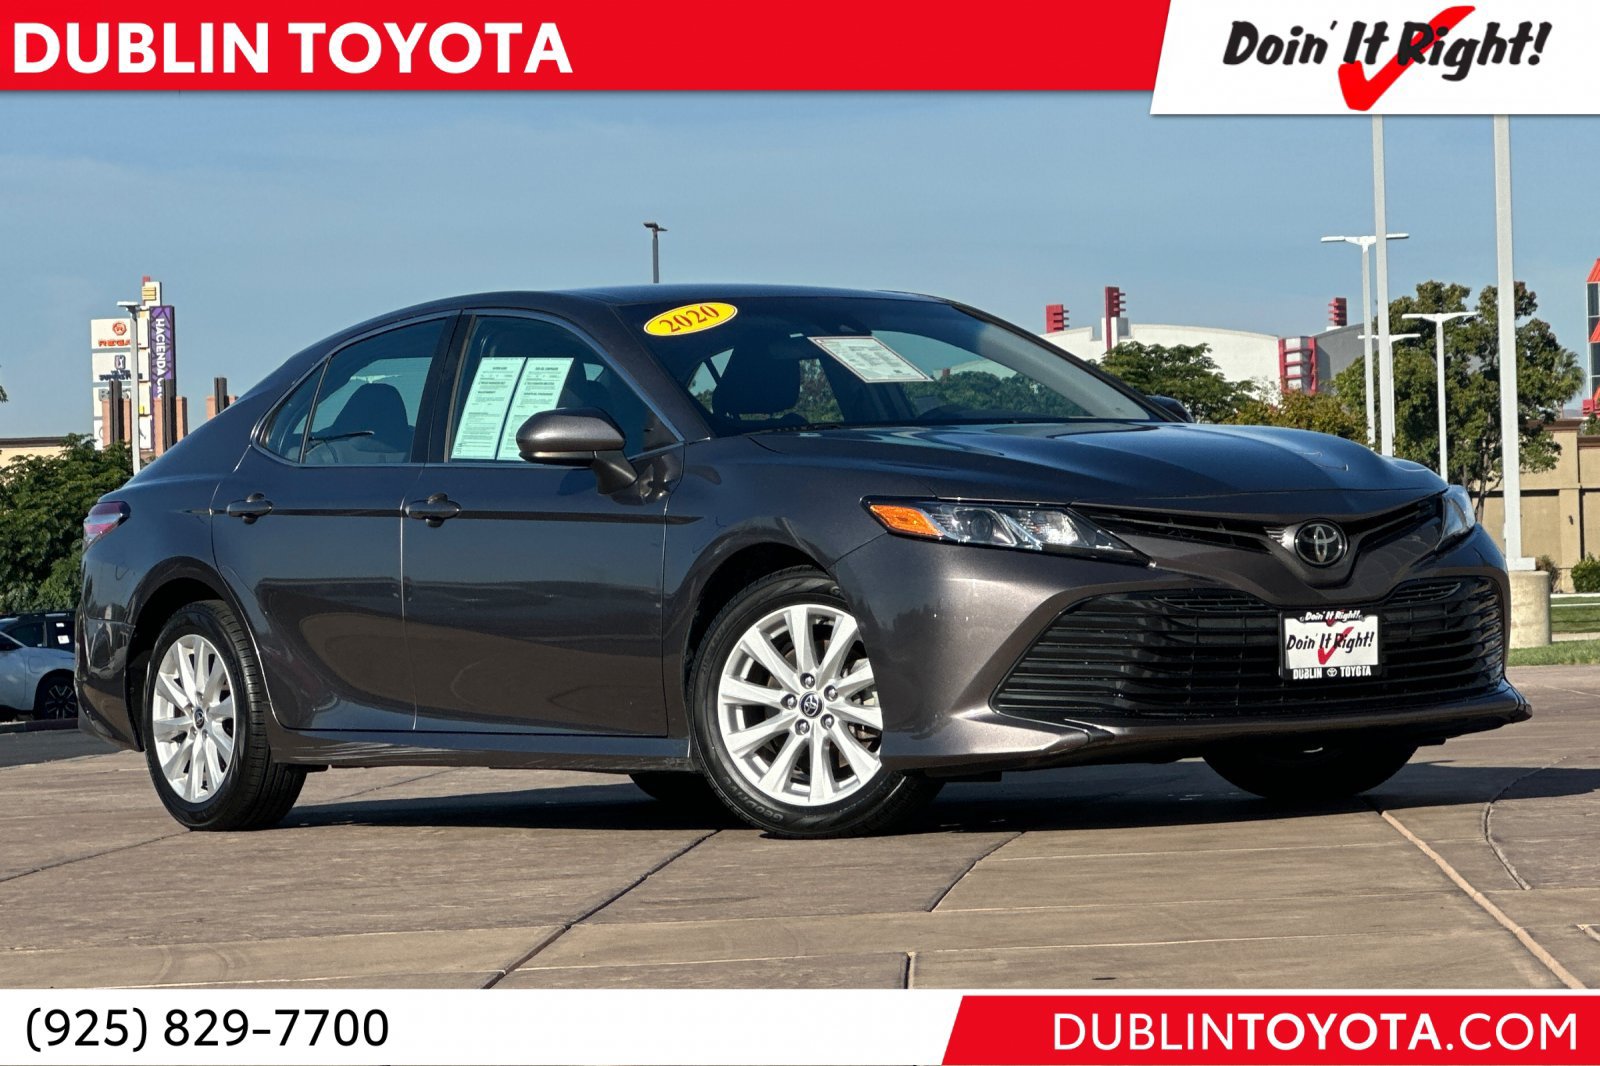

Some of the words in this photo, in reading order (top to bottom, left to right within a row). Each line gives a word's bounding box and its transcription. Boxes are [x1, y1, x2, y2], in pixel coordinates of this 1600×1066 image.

[659, 305, 720, 333] 2020
[98, 339, 142, 347] REGA
[155, 318, 166, 376] HACIENDA
[1305, 611, 1325, 621] Doin'
[1325, 610, 1334, 621] It
[1334, 610, 1361, 622] Right!
[1286, 633, 1318, 651] Doin'
[1319, 633, 1332, 649] It
[1334, 631, 1375, 654] Right!
[1293, 667, 1322, 680] DUBLIN
[1340, 665, 1371, 678] TOYOTA
